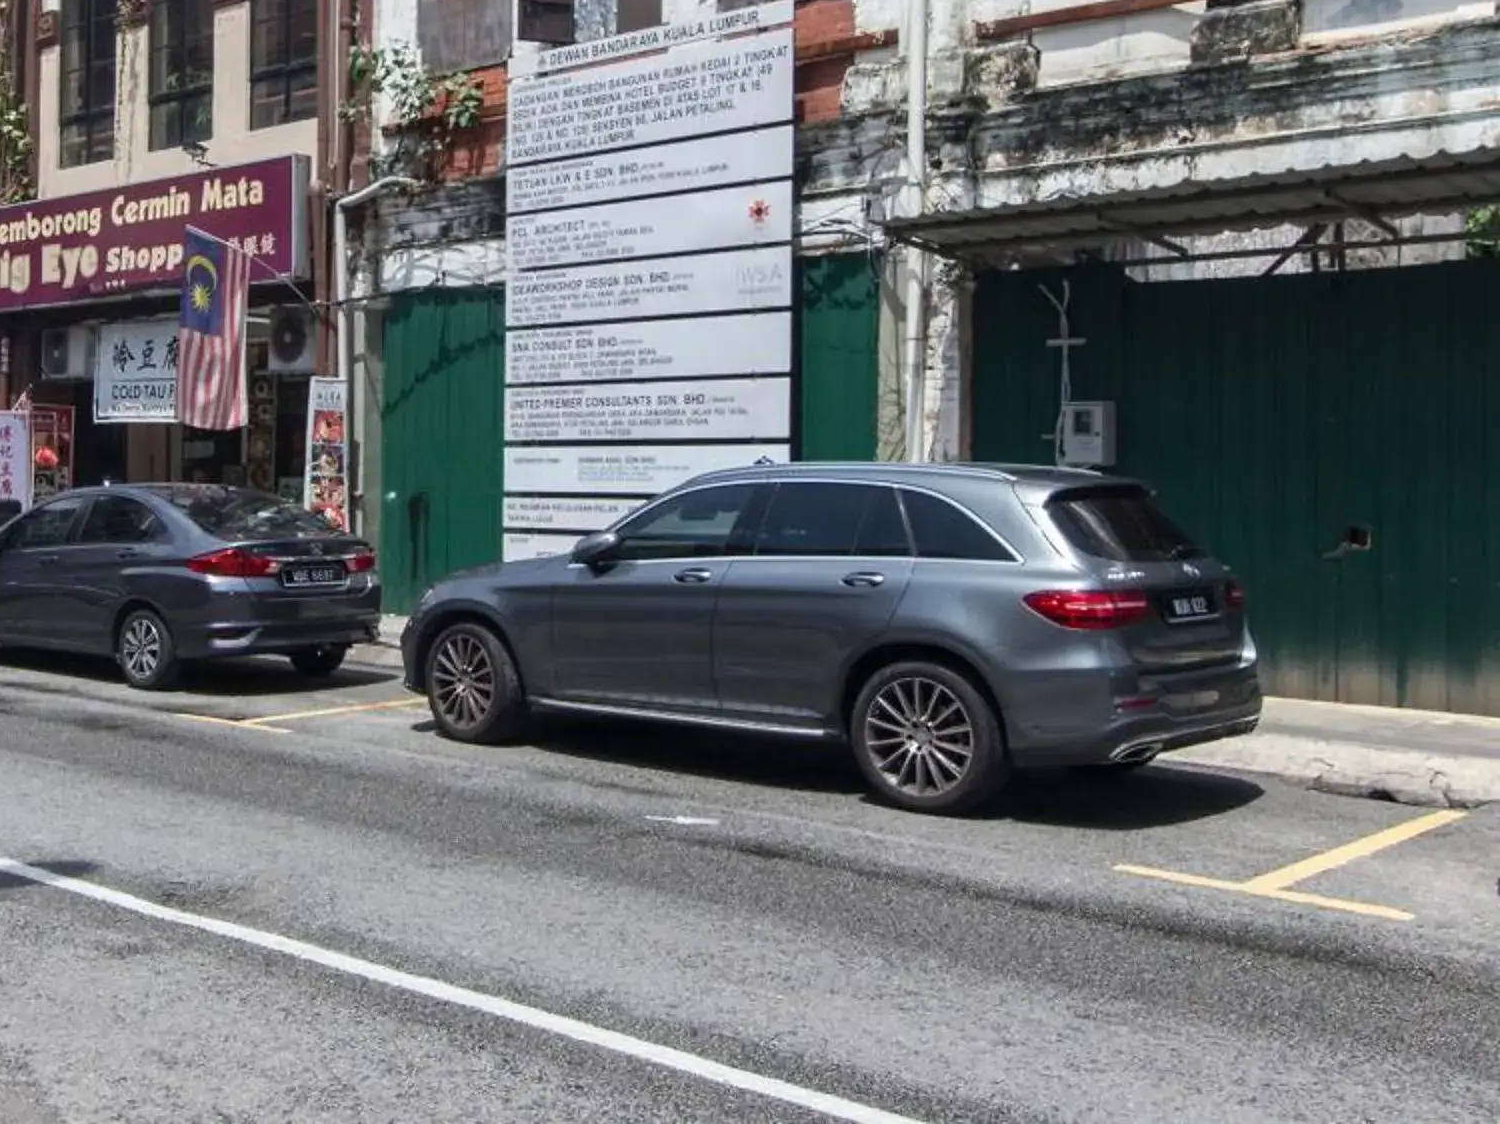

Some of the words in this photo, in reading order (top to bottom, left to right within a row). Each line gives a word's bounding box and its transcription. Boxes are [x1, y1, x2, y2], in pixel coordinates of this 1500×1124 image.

[549, 46, 590, 65] DEWAN
[591, 32, 659, 57] BANDARAYA
[663, 22, 705, 42] KUALA
[709, 10, 759, 33] LUMPUR
[744, 46, 787, 64] TINGKAT
[710, 66, 752, 85] TINGKAT
[651, 108, 682, 123] JALAN
[111, 186, 190, 226] Cermin
[201, 177, 263, 212] Mata
[41, 243, 98, 289] Eye
[105, 242, 184, 274] Shopp
[532, 339, 571, 351] CONSULT
[111, 384, 142, 400] COLD
[145, 384, 166, 399] TAU
[585, 395, 652, 407] CONSULTANTS
